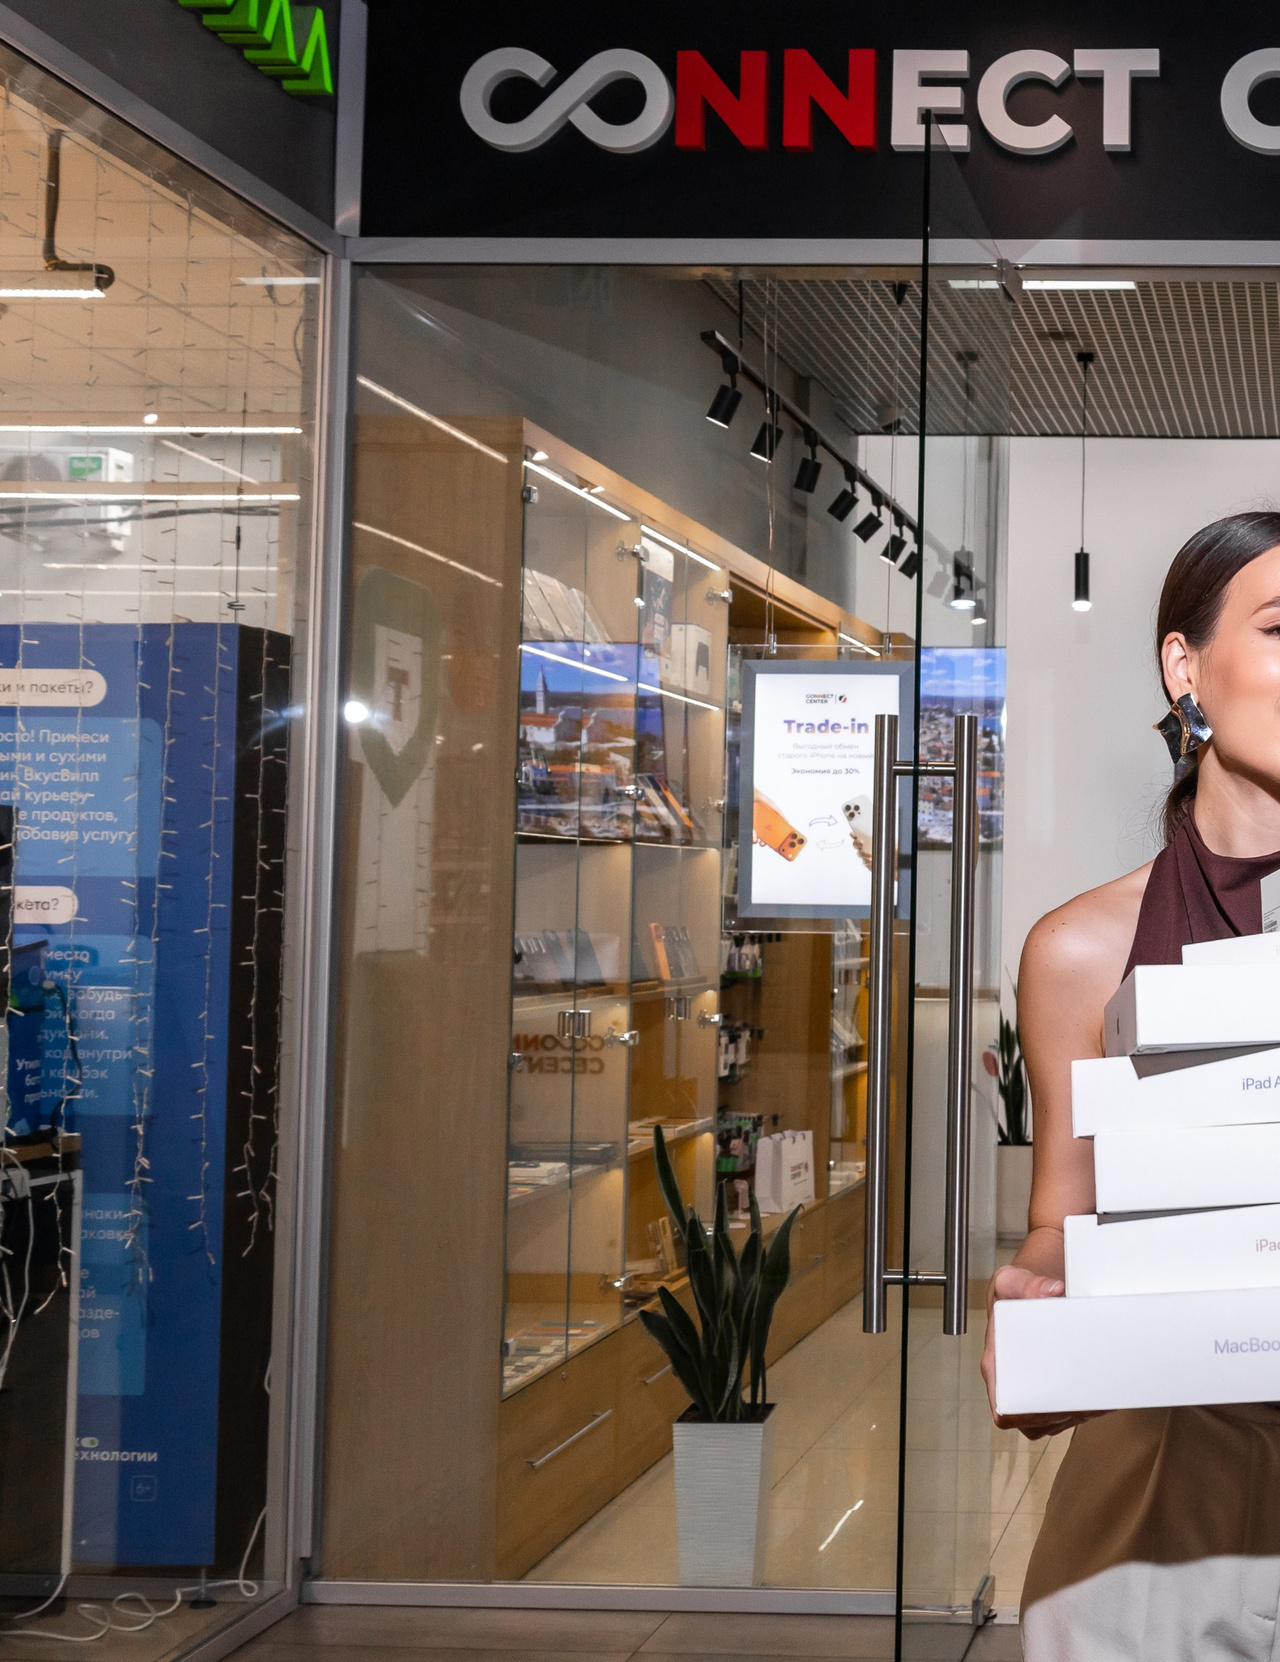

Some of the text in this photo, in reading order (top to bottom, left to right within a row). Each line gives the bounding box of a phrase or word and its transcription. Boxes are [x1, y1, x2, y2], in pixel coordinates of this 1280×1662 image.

[459, 45, 1161, 155] CONNECT
[29, 680, 94, 695] пакеты?
[783, 717, 870, 735] Trade-in
[39, 728, 109, 745] Принеси
[834, 742, 859, 750] обмен
[35, 752, 45, 763] и
[48, 751, 108, 765] сухими
[777, 752, 808, 760] старого
[809, 751, 836, 760] iPhone
[24, 768, 100, 785] ВкусВилл
[791, 767, 860, 777] Экономия до 30%
[24, 790, 89, 805] курьеру
[31, 809, 119, 824] продуктов,
[82, 829, 135, 844] услугу
[1241, 1075, 1273, 1092] iPad
[134, 1482, 152, 1495] 6+
